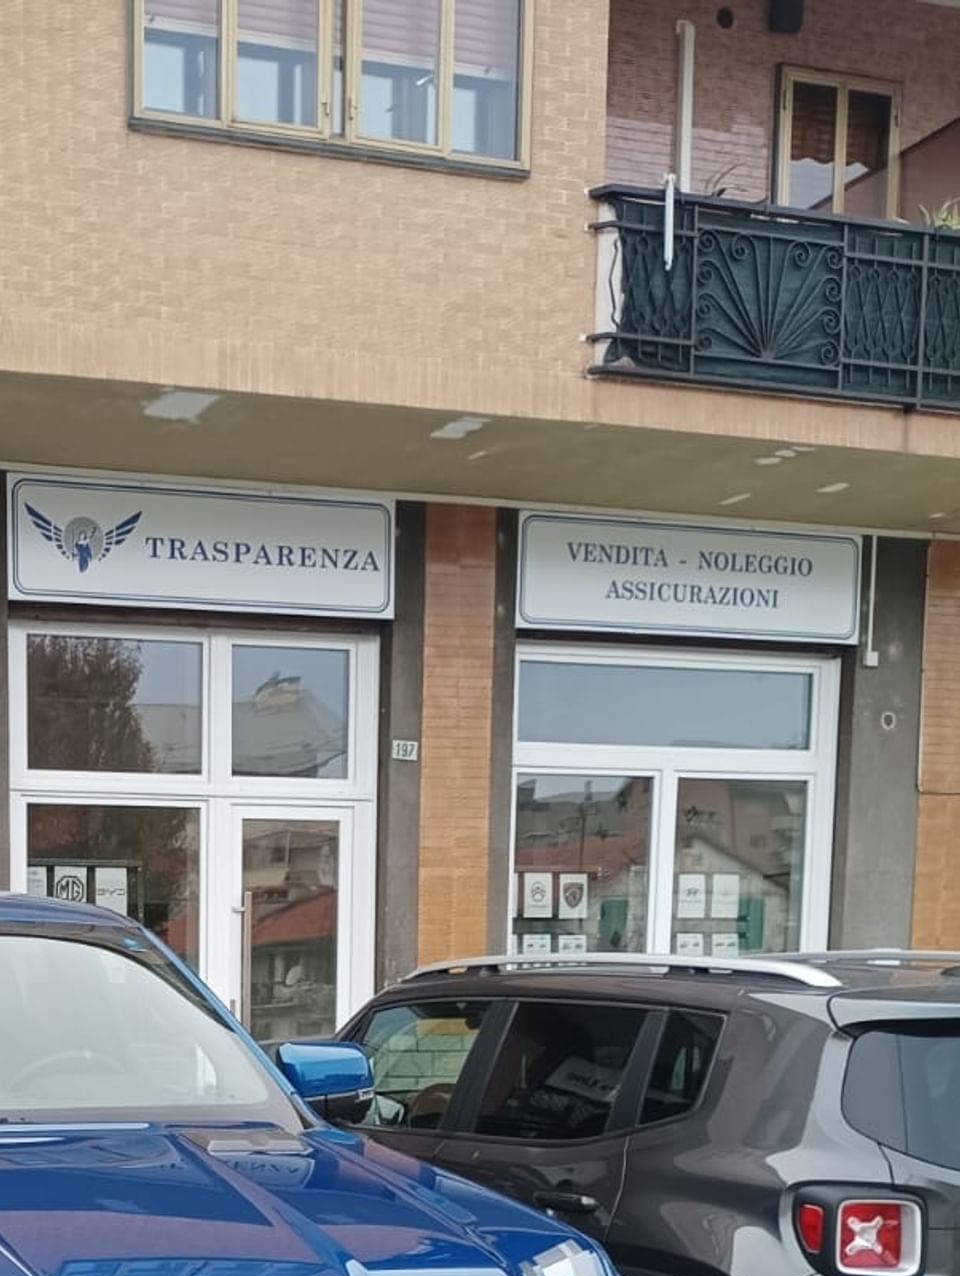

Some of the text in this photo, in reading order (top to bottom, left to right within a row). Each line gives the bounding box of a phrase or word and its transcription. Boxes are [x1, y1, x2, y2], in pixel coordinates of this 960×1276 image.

[145, 537, 381, 572] TRASPARENZA
[567, 542, 669, 568] VENDITA
[698, 551, 813, 577] NOLEGGIO
[605, 580, 779, 608] ASSICURAZIONI
[396, 743, 415, 757] 197
[60, 880, 81, 901] MG
